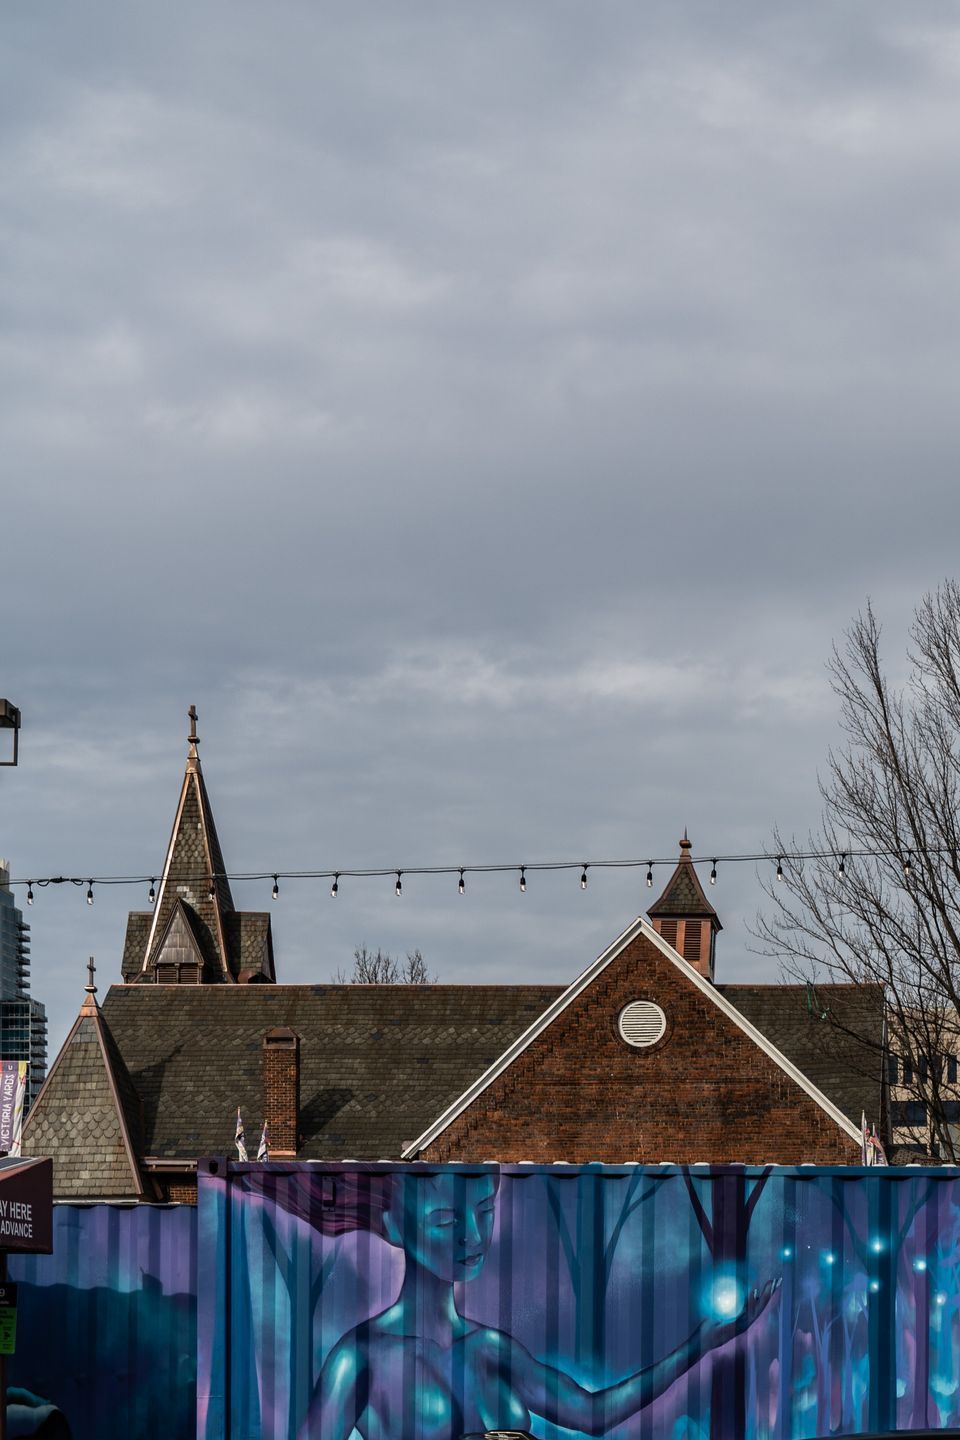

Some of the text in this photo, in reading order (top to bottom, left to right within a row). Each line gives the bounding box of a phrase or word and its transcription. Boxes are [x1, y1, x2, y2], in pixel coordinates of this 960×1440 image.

[1, 1074, 15, 1146] VICTORIA YARDS
[9, 1201, 32, 1221] HERE
[0, 1220, 33, 1238] ADVANCE
